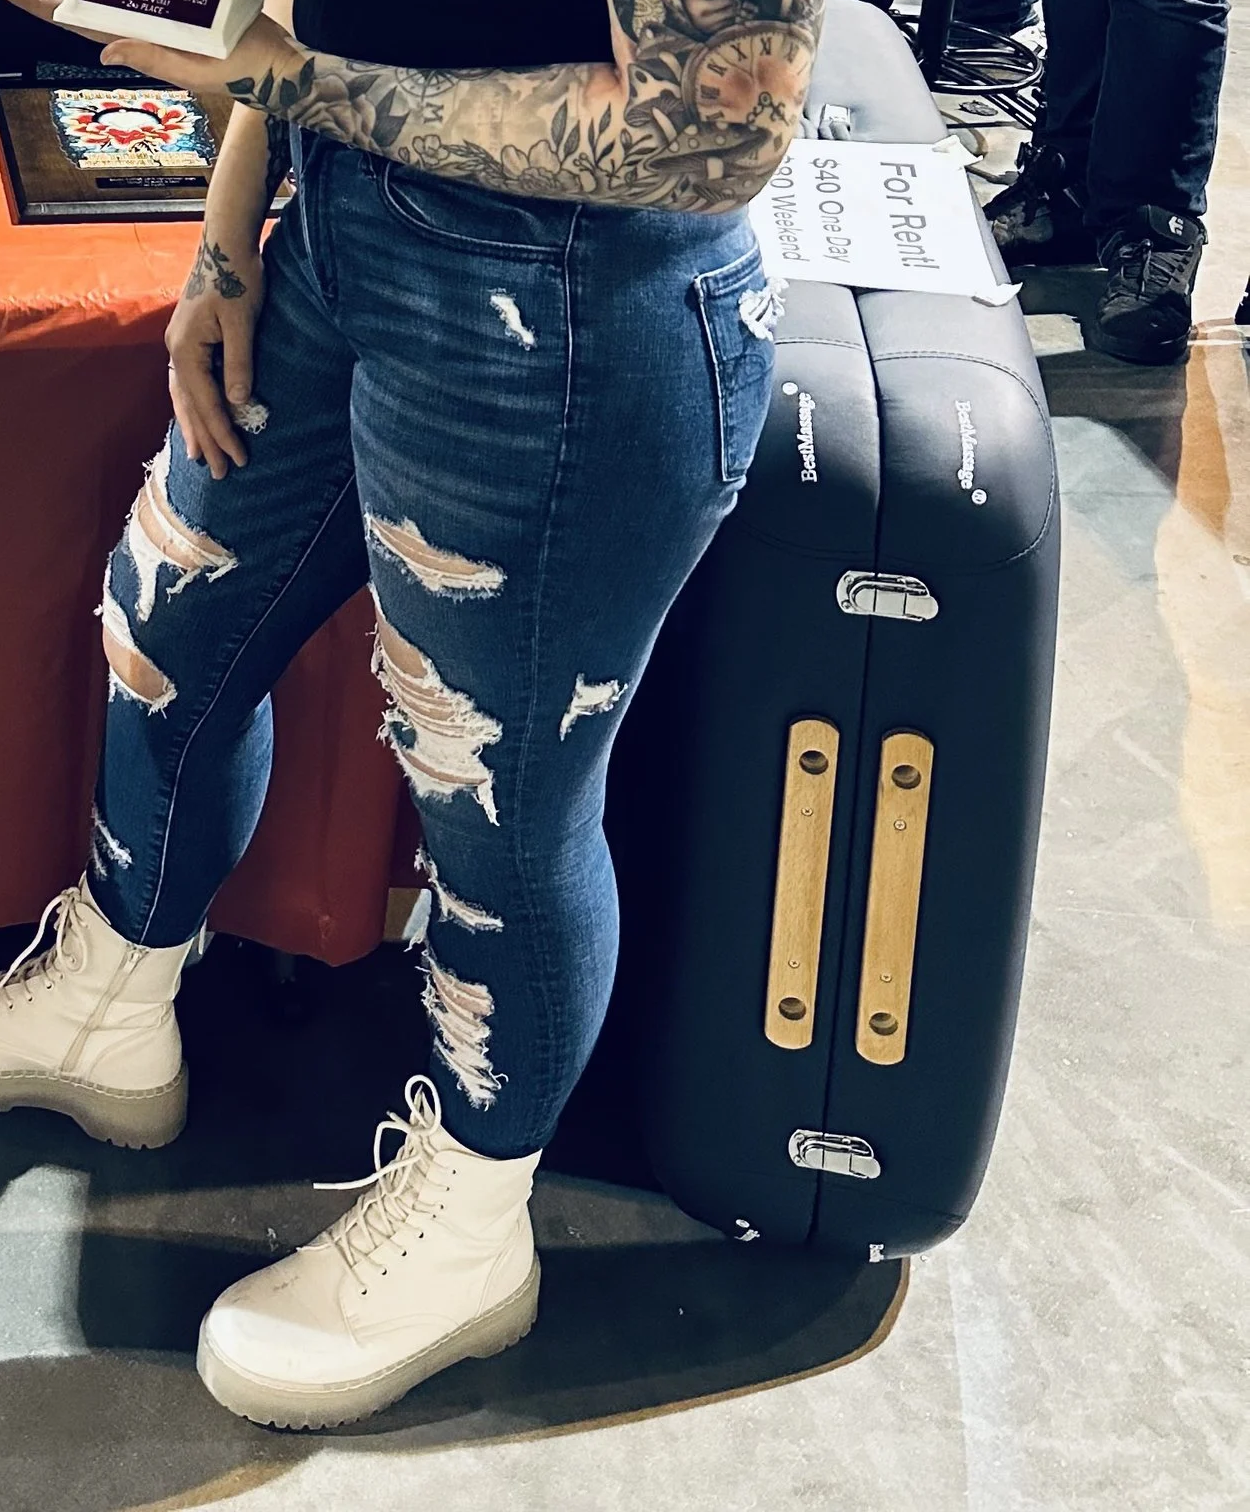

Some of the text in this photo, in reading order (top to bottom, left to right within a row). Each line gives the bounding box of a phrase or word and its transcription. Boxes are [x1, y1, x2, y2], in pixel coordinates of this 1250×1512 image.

[140, 2, 165, 15] PLACE
[771, 194, 810, 262] Weekend
[809, 157, 851, 263] $40 One Day
[880, 161, 940, 270] For Rent!
[798, 391, 817, 483] BestMassage
[955, 400, 978, 490] BestMassage
